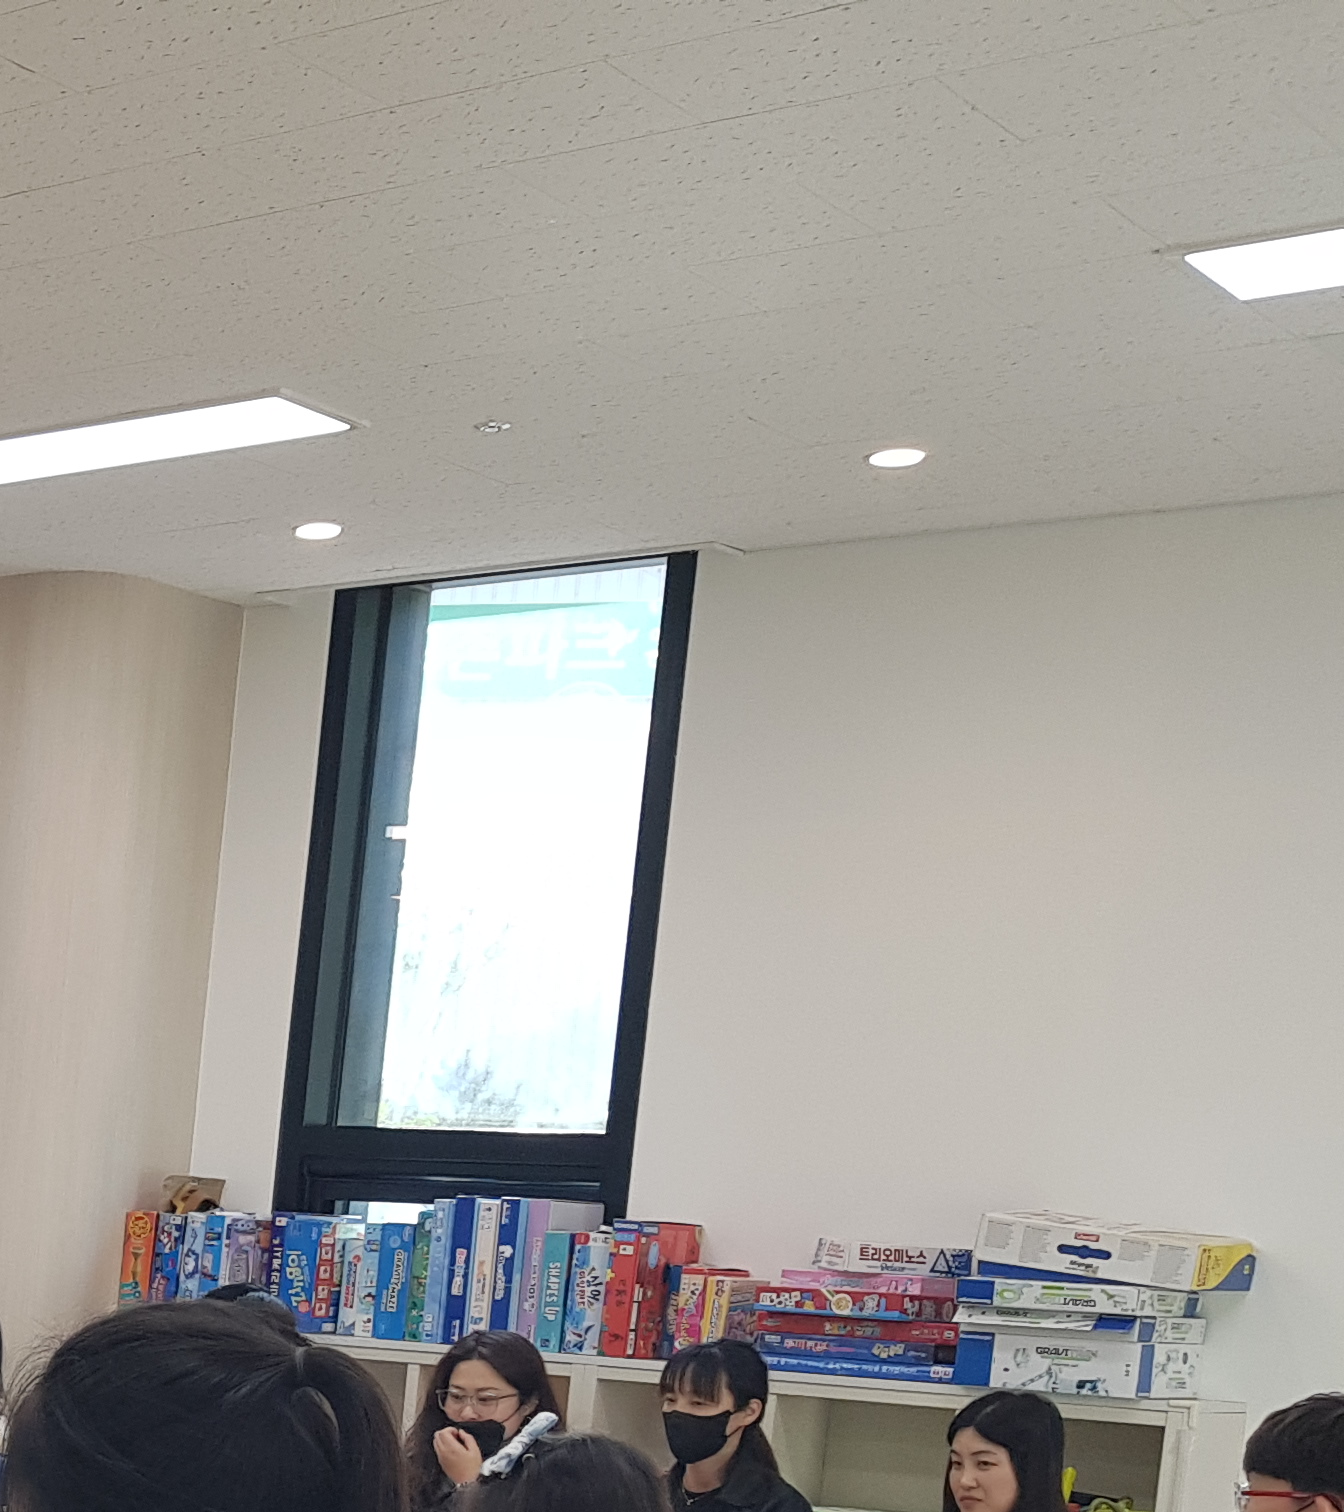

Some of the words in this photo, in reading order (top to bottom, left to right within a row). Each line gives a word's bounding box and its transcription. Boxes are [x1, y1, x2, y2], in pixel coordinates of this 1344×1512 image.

[858, 1246, 928, 1264] 트리오미노스
[545, 1261, 561, 1303] SHAPES
[543, 1306, 561, 1321] UP
